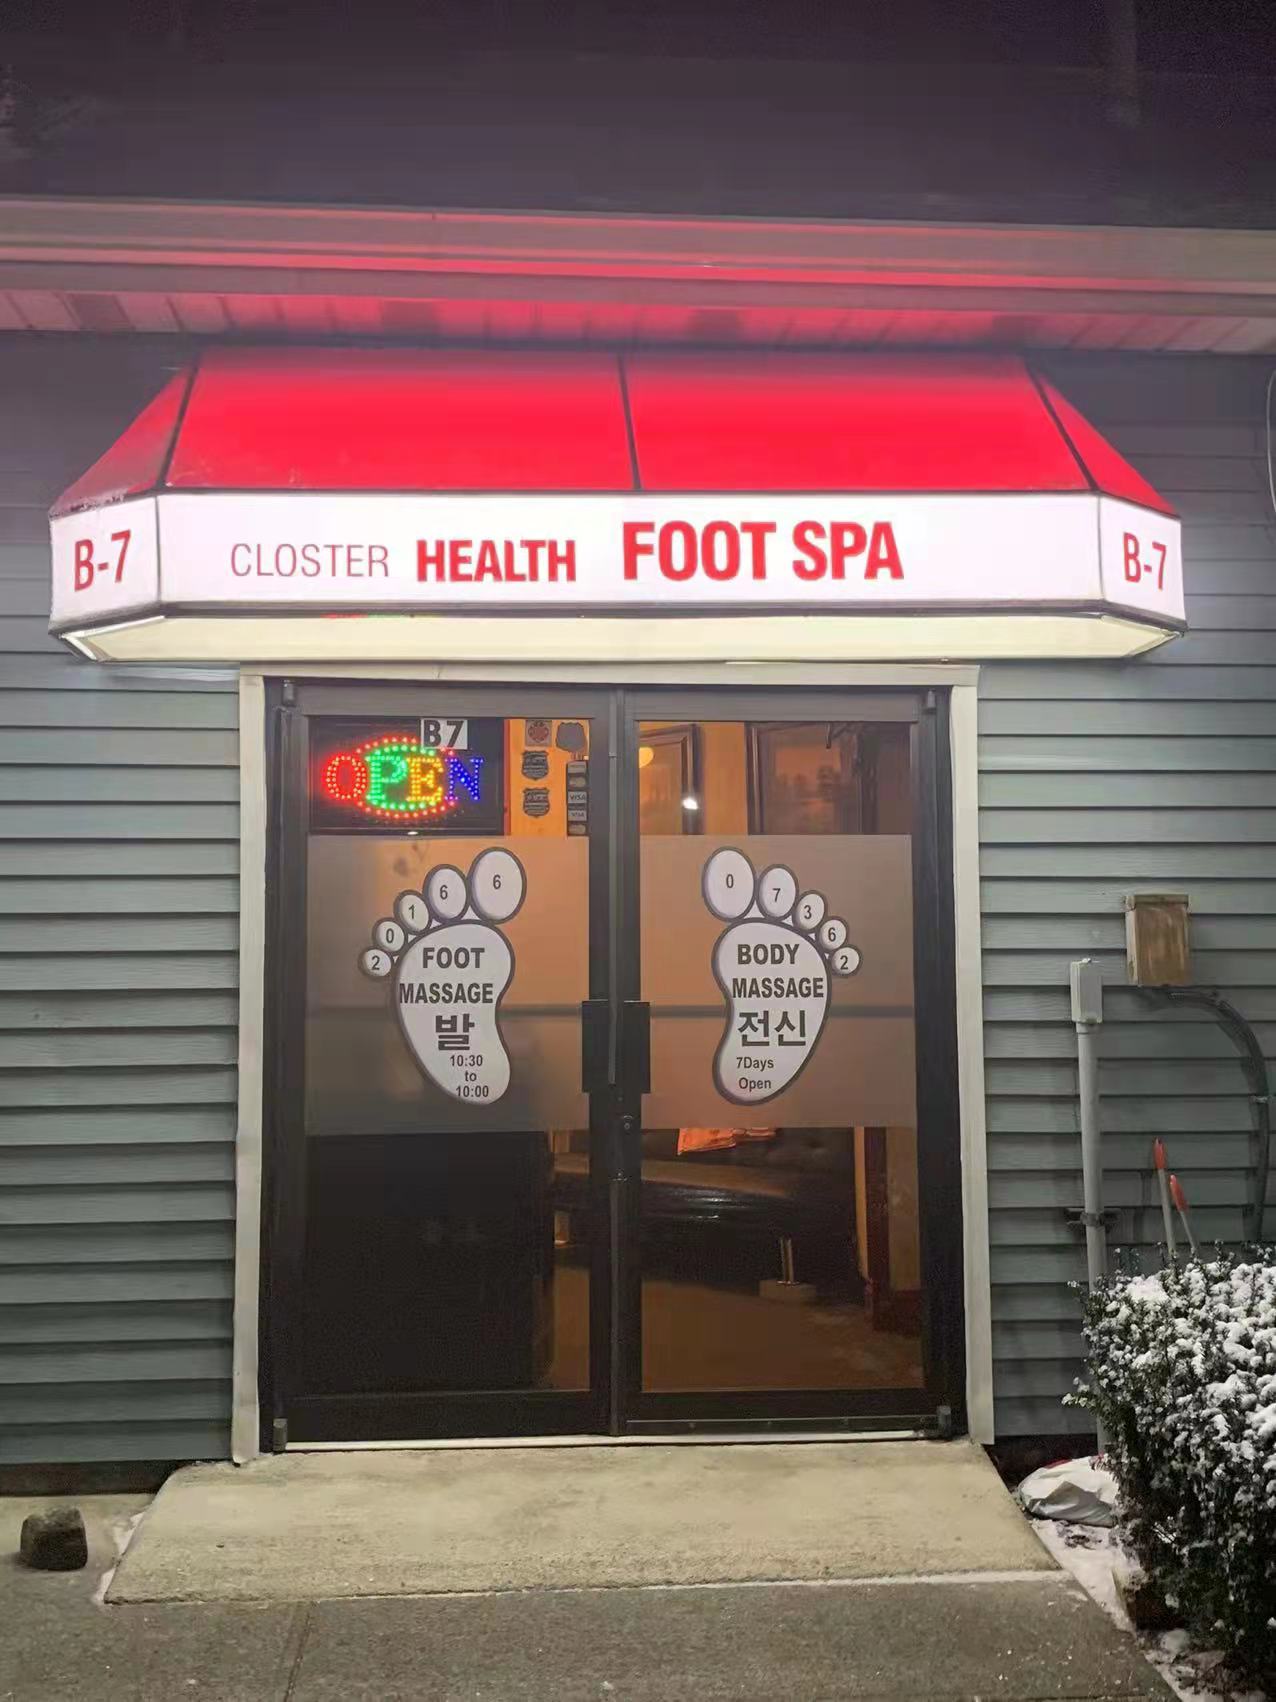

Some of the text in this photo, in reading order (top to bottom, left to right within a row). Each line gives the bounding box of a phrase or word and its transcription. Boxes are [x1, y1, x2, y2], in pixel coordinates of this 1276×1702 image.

[74, 529, 132, 592] B-7
[230, 521, 904, 583] CLOSTER HEALTH FOOT SPA
[1123, 531, 1167, 591] B-7
[423, 719, 465, 748] B7
[325, 754, 485, 802] OPEN
[371, 955, 381, 971] 2
[439, 884, 448, 900] 6
[492, 874, 502, 890] 6
[772, 887, 781, 903] 7
[803, 904, 812, 920] 3
[827, 926, 837, 942] 6
[840, 955, 849, 971] 2
[422, 947, 485, 969] FOOT
[737, 943, 800, 965] BODY
[399, 982, 494, 1004] MASSAGE
[732, 977, 824, 999] MASSAGE
[435, 1013, 475, 1051] 발
[737, 1009, 807, 1047] 전신
[449, 1054, 483, 1067] 10:30
[736, 1056, 774, 1072] 7Days
[465, 1070, 477, 1082] to
[738, 1077, 772, 1092] Open
[455, 1085, 489, 1098] 10:00
